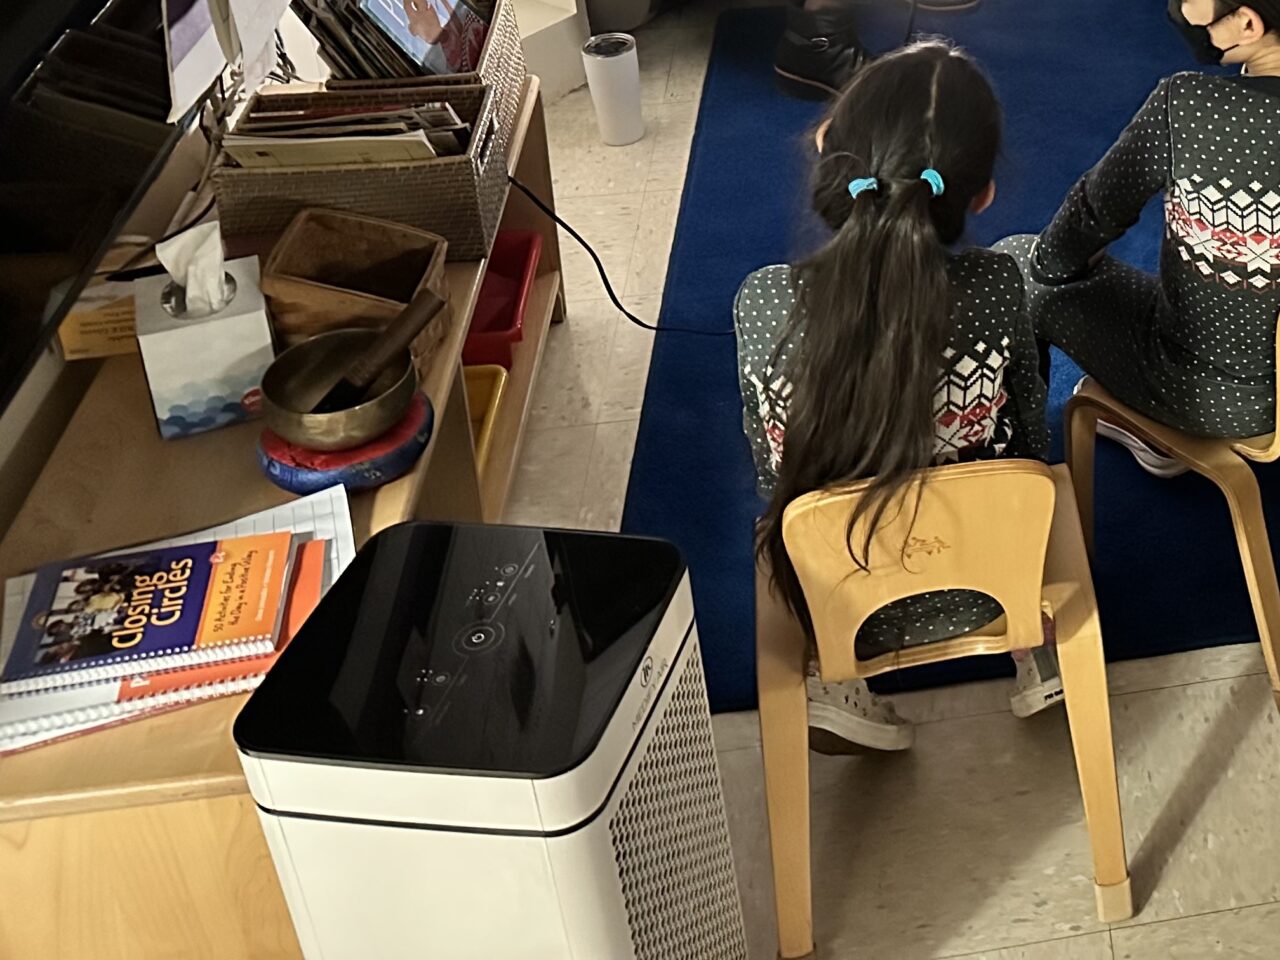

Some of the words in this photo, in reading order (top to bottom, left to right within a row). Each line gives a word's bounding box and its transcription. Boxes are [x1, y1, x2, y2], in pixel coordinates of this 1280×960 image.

[111, 571, 168, 649] Closing
[150, 558, 193, 627] Circles
[214, 595, 231, 622] Activities
